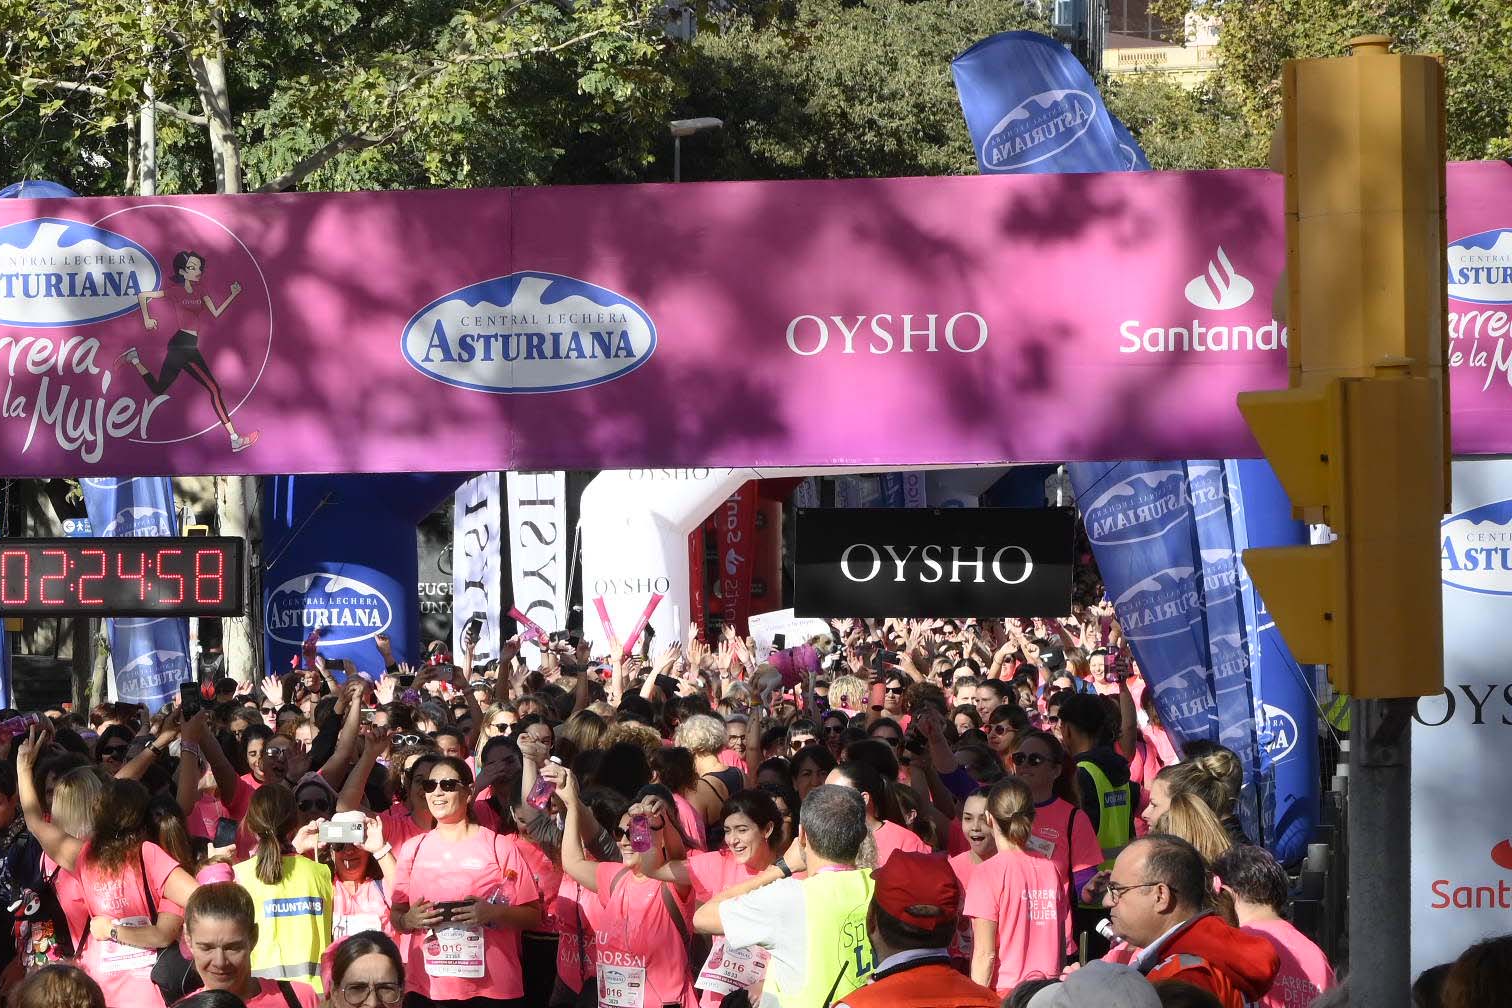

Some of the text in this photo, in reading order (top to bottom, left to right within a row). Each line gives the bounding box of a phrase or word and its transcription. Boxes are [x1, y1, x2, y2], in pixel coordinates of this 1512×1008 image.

[62, 254, 136, 267] LECHERA
[460, 311, 629, 328] CENTRAL LECHERA
[785, 311, 989, 356] OYSHO
[420, 318, 637, 364] ASTURIANA
[1469, 339, 1488, 367] la
[1, 380, 27, 419] la
[20, 368, 172, 464] Mujer
[0, 549, 224, 604] 02:24:58
[840, 543, 1034, 585] OYSHO
[594, 576, 670, 594] OYSHO
[329, 597, 378, 606] LECHERA
[270, 602, 383, 630] ASTURIANA
[723, 959, 745, 973] 016
[606, 987, 623, 998] 016
